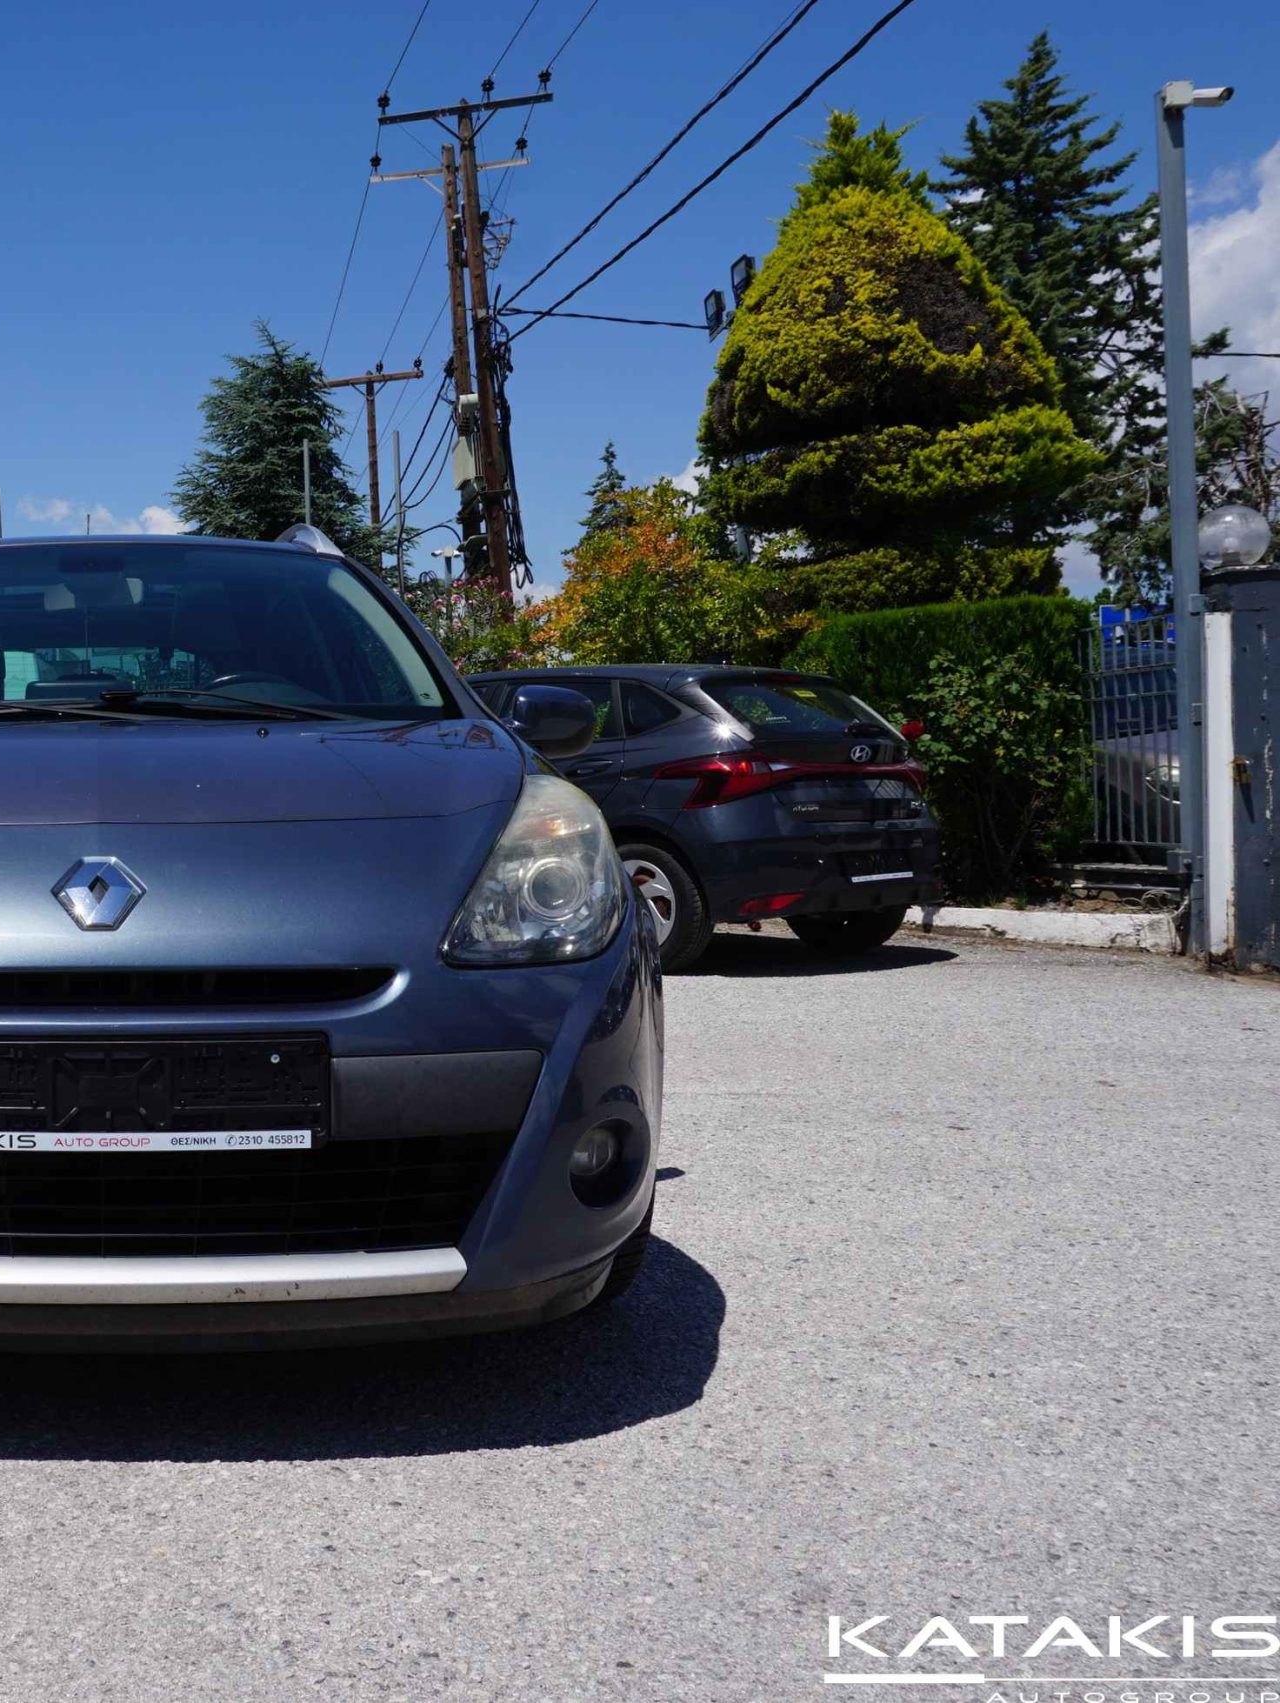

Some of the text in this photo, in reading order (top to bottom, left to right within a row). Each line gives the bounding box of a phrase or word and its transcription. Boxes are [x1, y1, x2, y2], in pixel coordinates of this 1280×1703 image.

[54, 1137, 94, 1147] AUTO
[99, 1137, 151, 1147] GROUP
[170, 1134, 305, 1146] ΘΕΣ/ΝΙΚΗ 2310 455812
